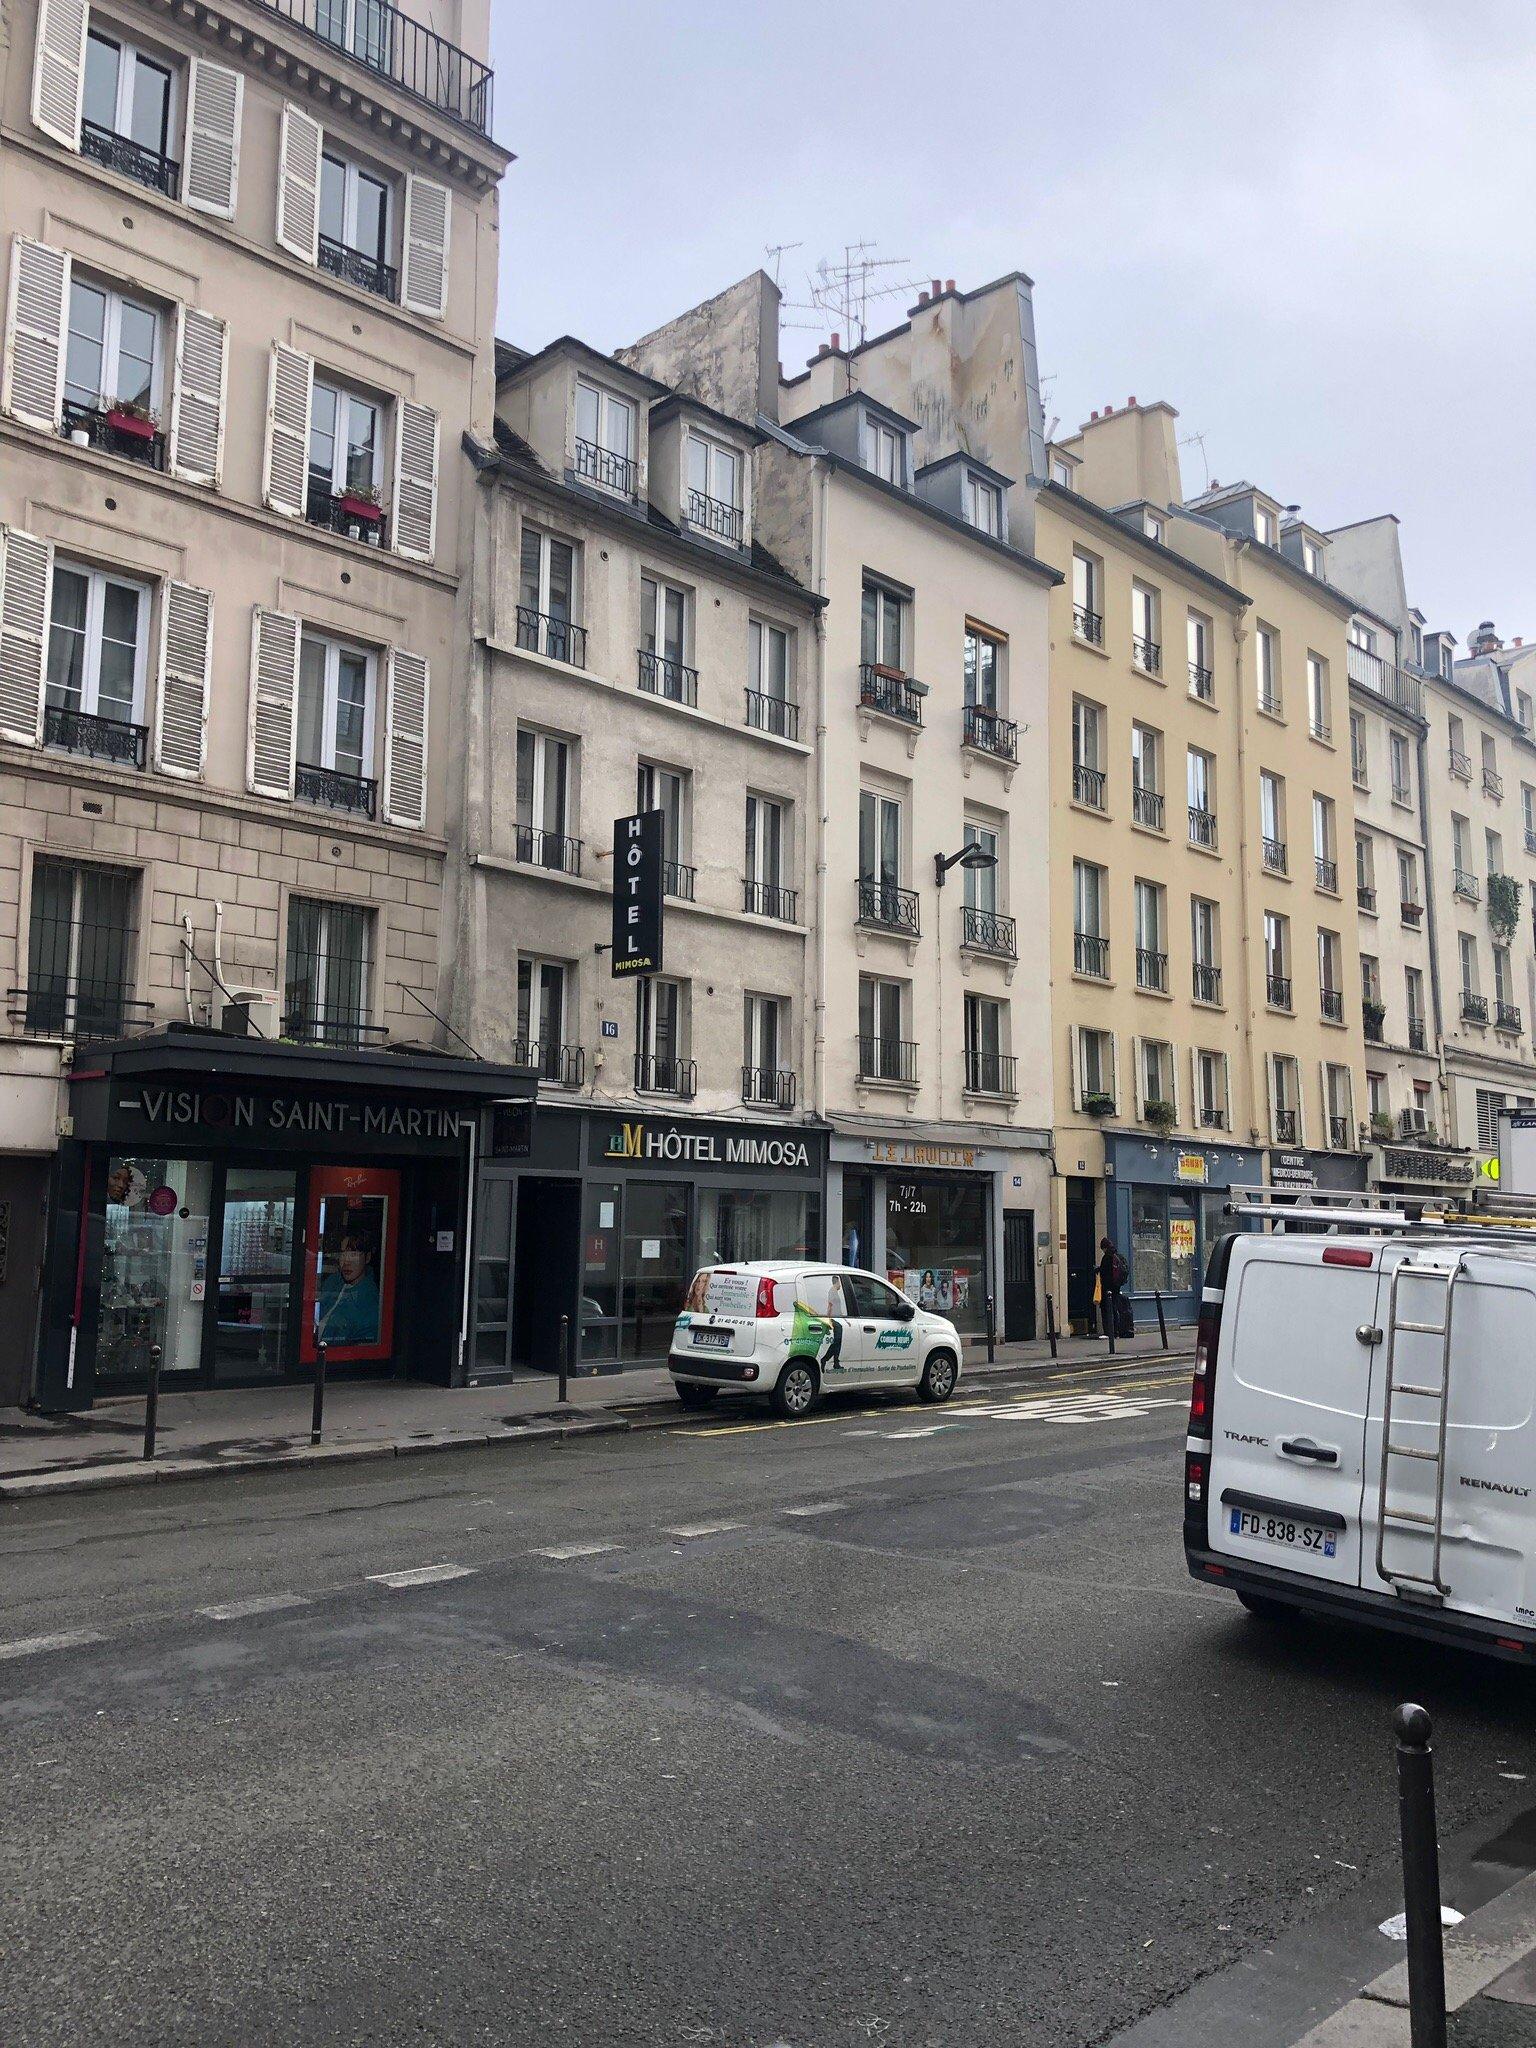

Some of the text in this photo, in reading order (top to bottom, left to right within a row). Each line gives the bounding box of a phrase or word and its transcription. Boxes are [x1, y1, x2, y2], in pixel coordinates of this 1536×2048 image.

[626, 818, 643, 954] HÔTEL
[615, 957, 652, 971] MIMOSA
[605, 1022, 616, 1036] 16
[142, 1090, 460, 1138] VISION SAINT-MARTIN
[646, 1127, 722, 1162] HÔTEL
[725, 1137, 810, 1167] MIMOSA
[899, 1185, 917, 1199] 7j/7
[889, 1200, 901, 1212] 7h
[909, 1201, 927, 1213] 22h
[594, 1239, 603, 1250] H
[1223, 1430, 1269, 1447] TRAFIC
[1459, 1476, 1532, 1498] RENAULT
[1240, 1512, 1324, 1550] FD-838-SZ
[1515, 1606, 1535, 1617] LMPC
